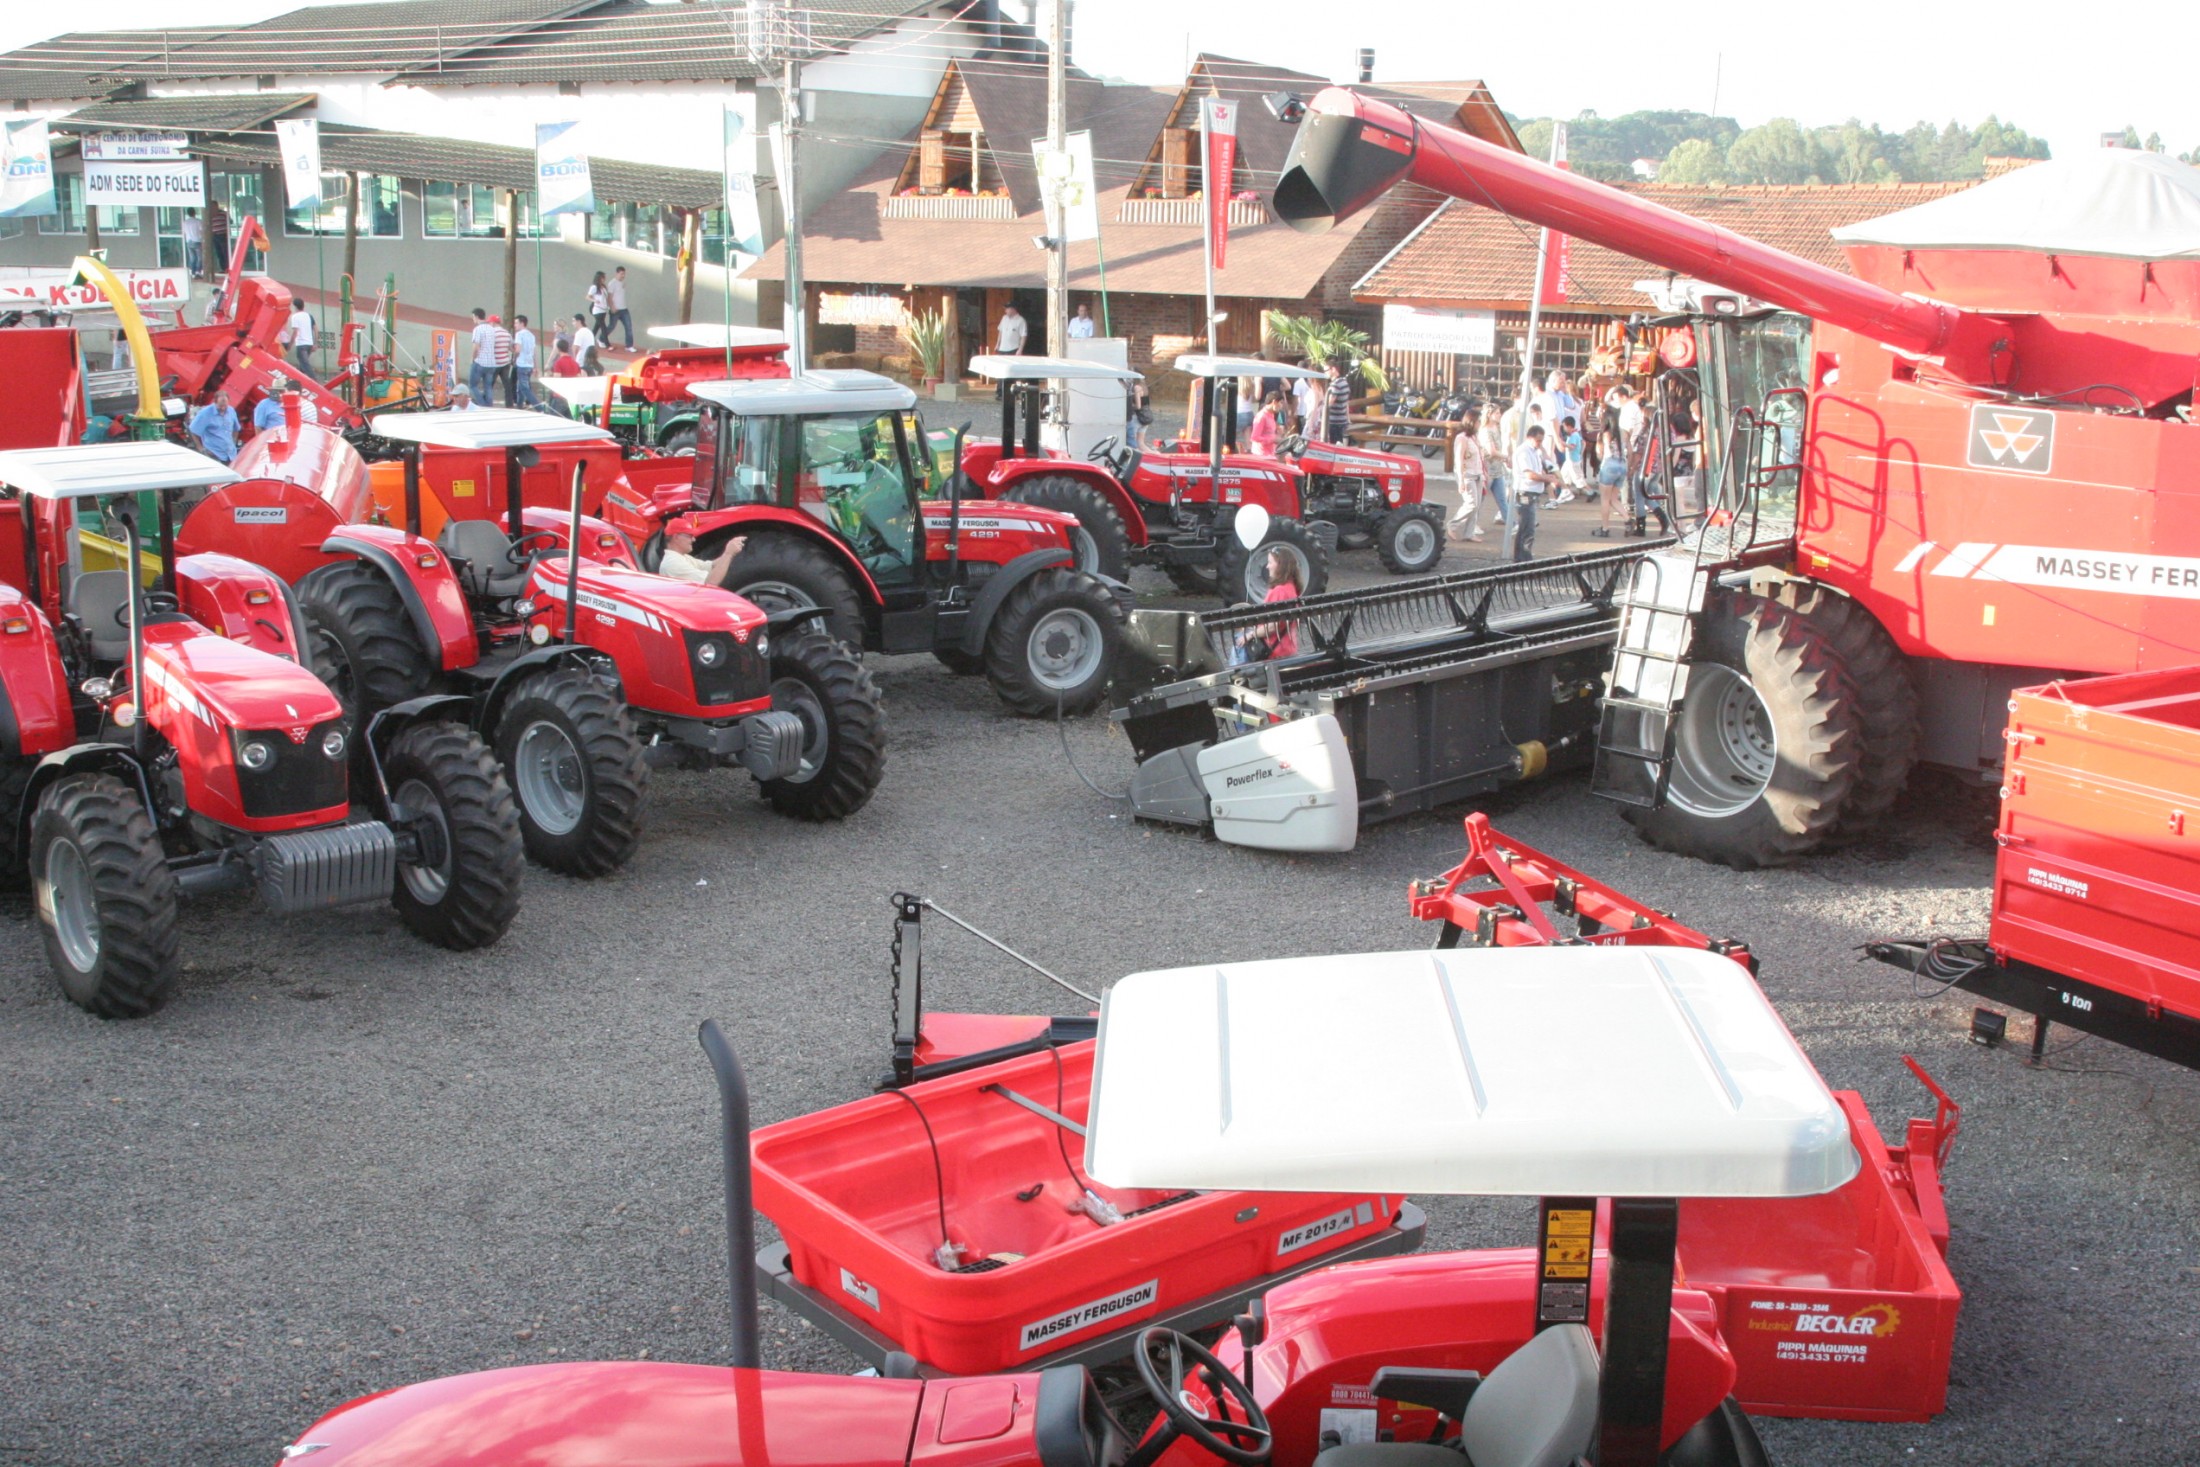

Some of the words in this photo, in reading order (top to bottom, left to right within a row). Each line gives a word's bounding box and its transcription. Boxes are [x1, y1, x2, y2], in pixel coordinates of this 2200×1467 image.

[128, 146, 148, 155] CARNE
[540, 164, 587, 177] BONI
[89, 174, 113, 191] ADM
[115, 175, 143, 191] SEDE
[146, 175, 162, 192] DO
[165, 175, 200, 192] FOLLE
[2036, 556, 2139, 583] MASSEY
[593, 598, 617, 612] FERGUSON
[595, 613, 616, 627] 4292
[1226, 768, 1273, 788] Powerflex
[2028, 867, 2047, 880] PIPPI
[2027, 876, 2063, 893] (49)3433
[2064, 886, 2087, 899] 0714
[2072, 994, 2092, 1012] ton
[1282, 1233, 1303, 1248] MF
[1304, 1218, 1338, 1241] 2013
[1027, 1311, 1083, 1343] MASSEY
[1083, 1286, 1152, 1321] FERGUSON
[1795, 1314, 1877, 1335] BECKER
[1776, 1351, 1830, 1362] (49)3433
[1834, 1353, 1866, 1363] 0714
[1777, 1341, 1806, 1352] PIPPI
[1808, 1341, 1867, 1355] MÁQUINAS
